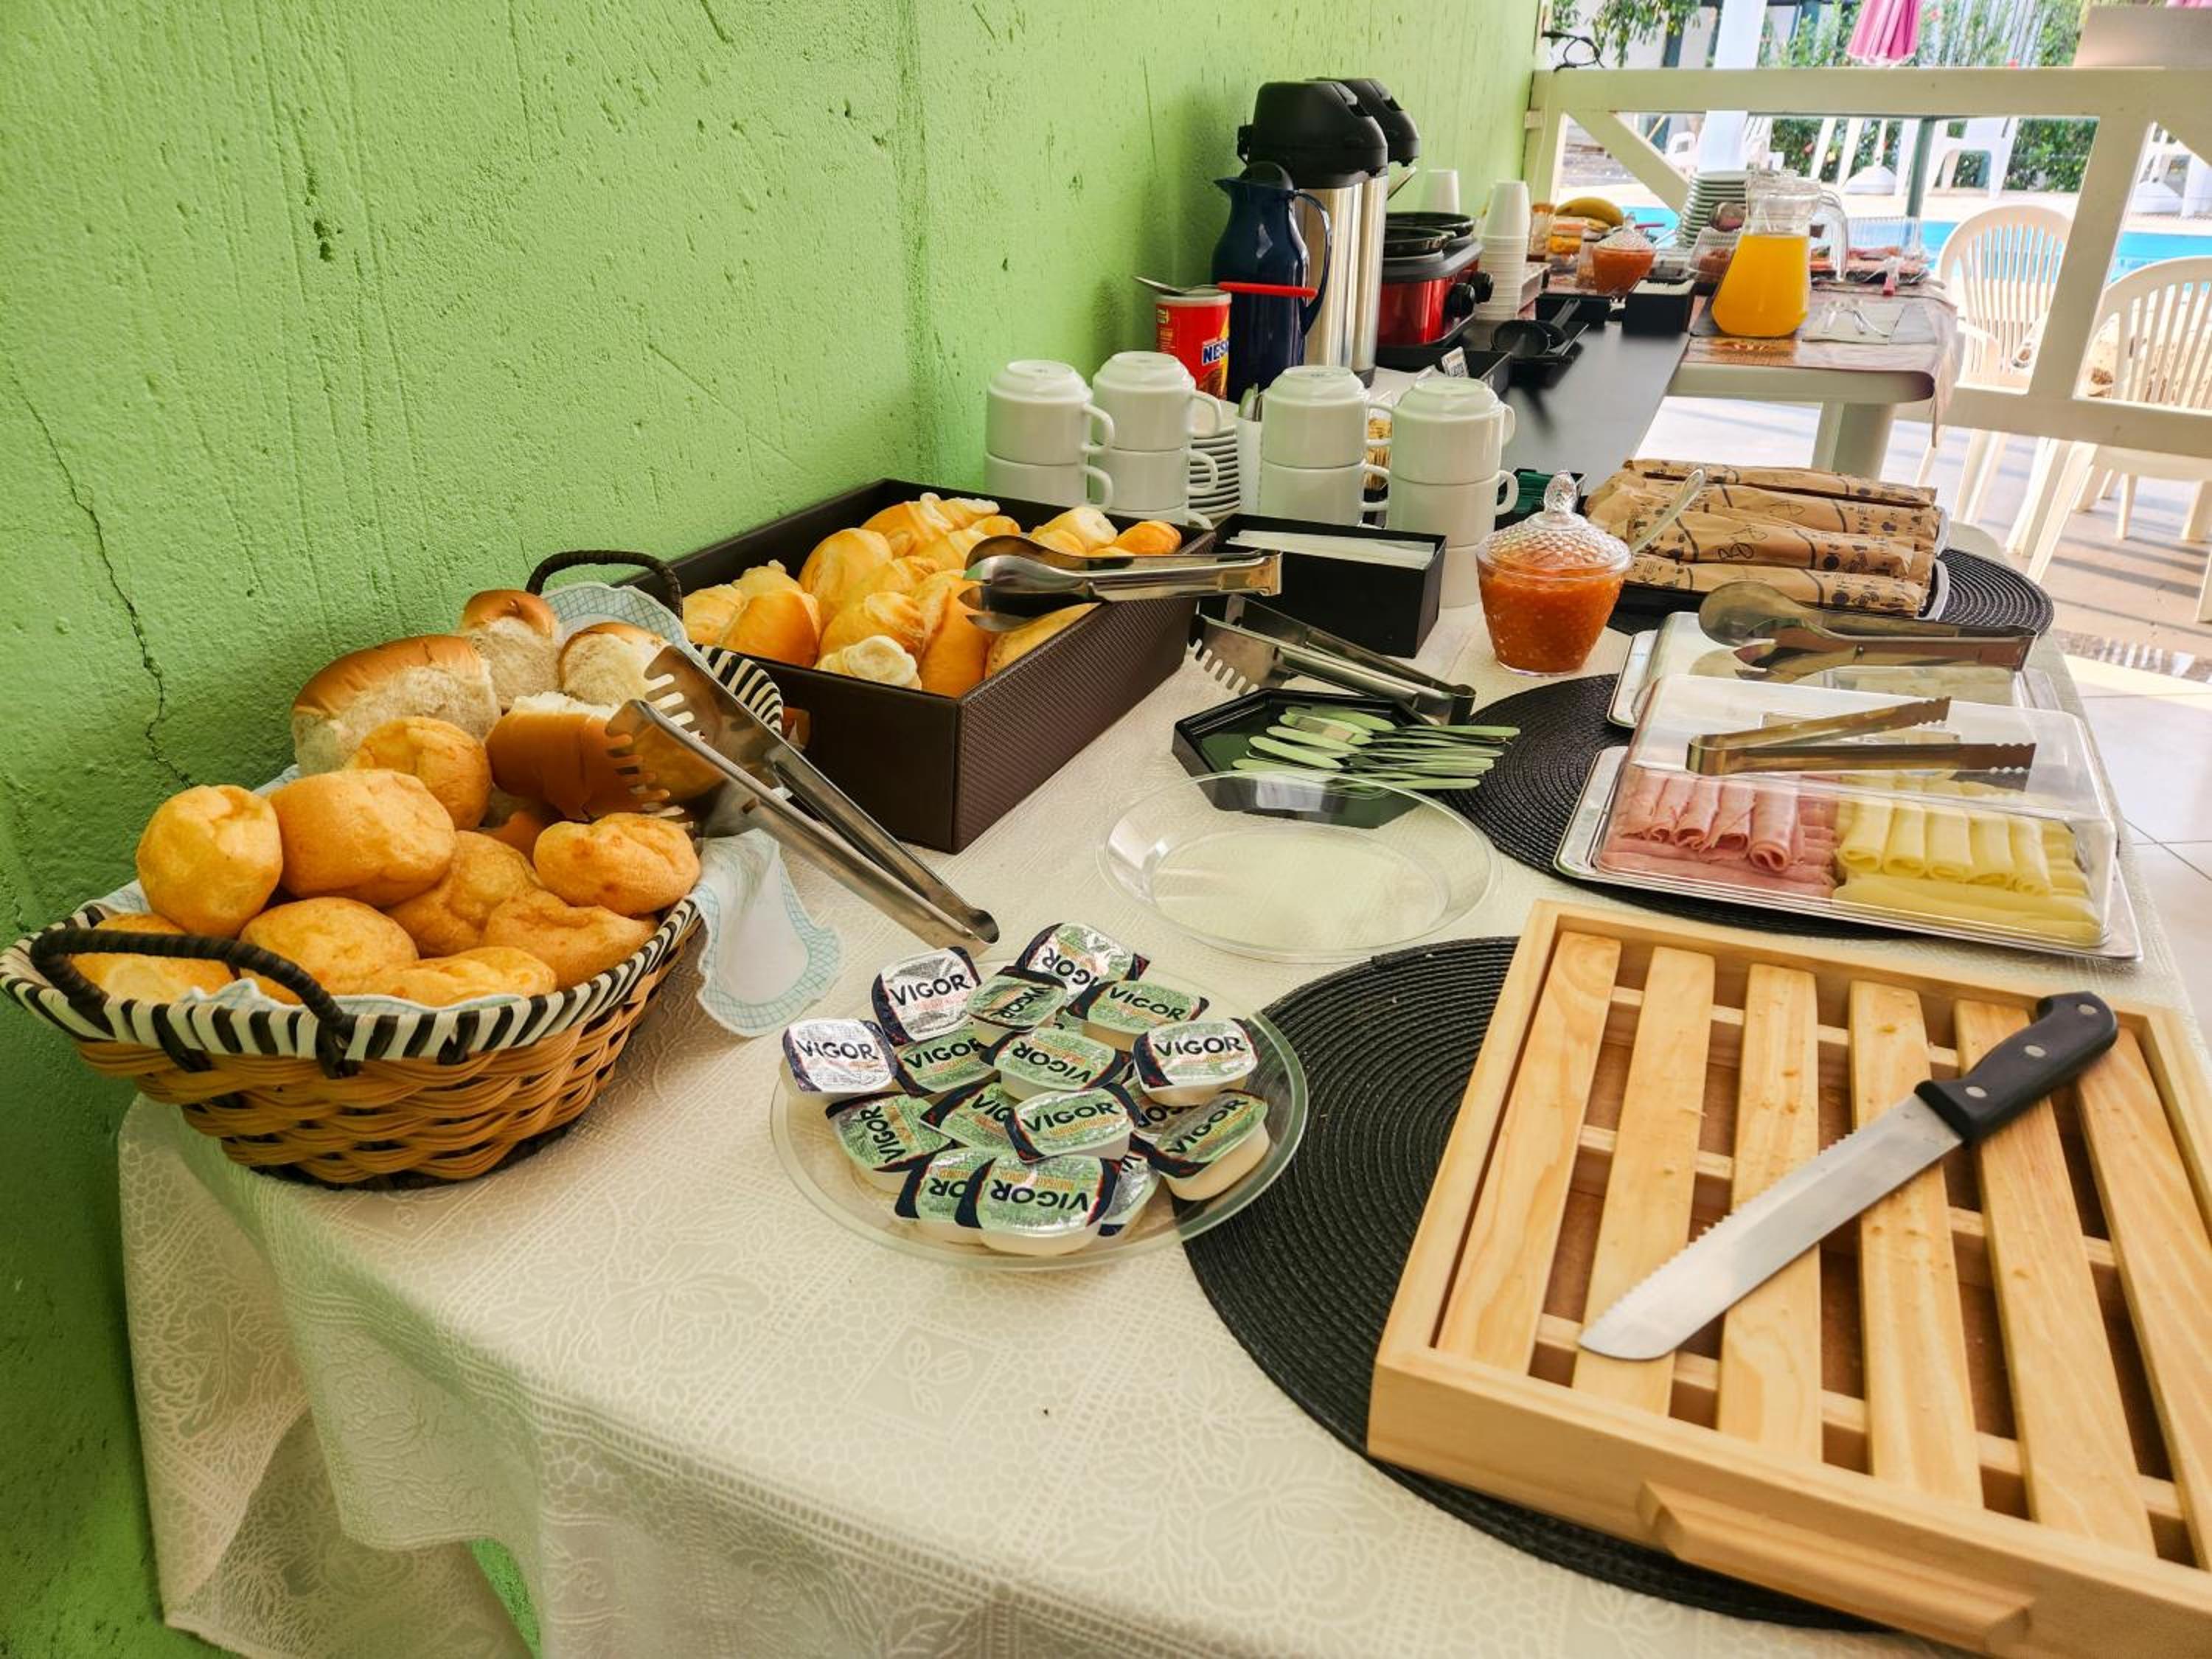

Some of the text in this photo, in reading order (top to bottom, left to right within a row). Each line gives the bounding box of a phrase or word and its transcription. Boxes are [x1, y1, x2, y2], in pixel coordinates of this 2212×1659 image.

[1042, 947, 1099, 987] IGOR
[888, 973, 970, 1006] VIGOR
[1108, 986, 1187, 1020] VIGOR
[796, 1040, 879, 1060] VIGOR
[1012, 1041, 1093, 1083] VIGOR
[1153, 1036, 1245, 1057] VIGOR
[971, 1094, 1013, 1122] VIG
[1021, 1102, 1120, 1132] VIGOR
[859, 1105, 907, 1164] VIGOR
[1166, 1098, 1248, 1155] VIGOR
[990, 1179, 1089, 1212] VIGOR
